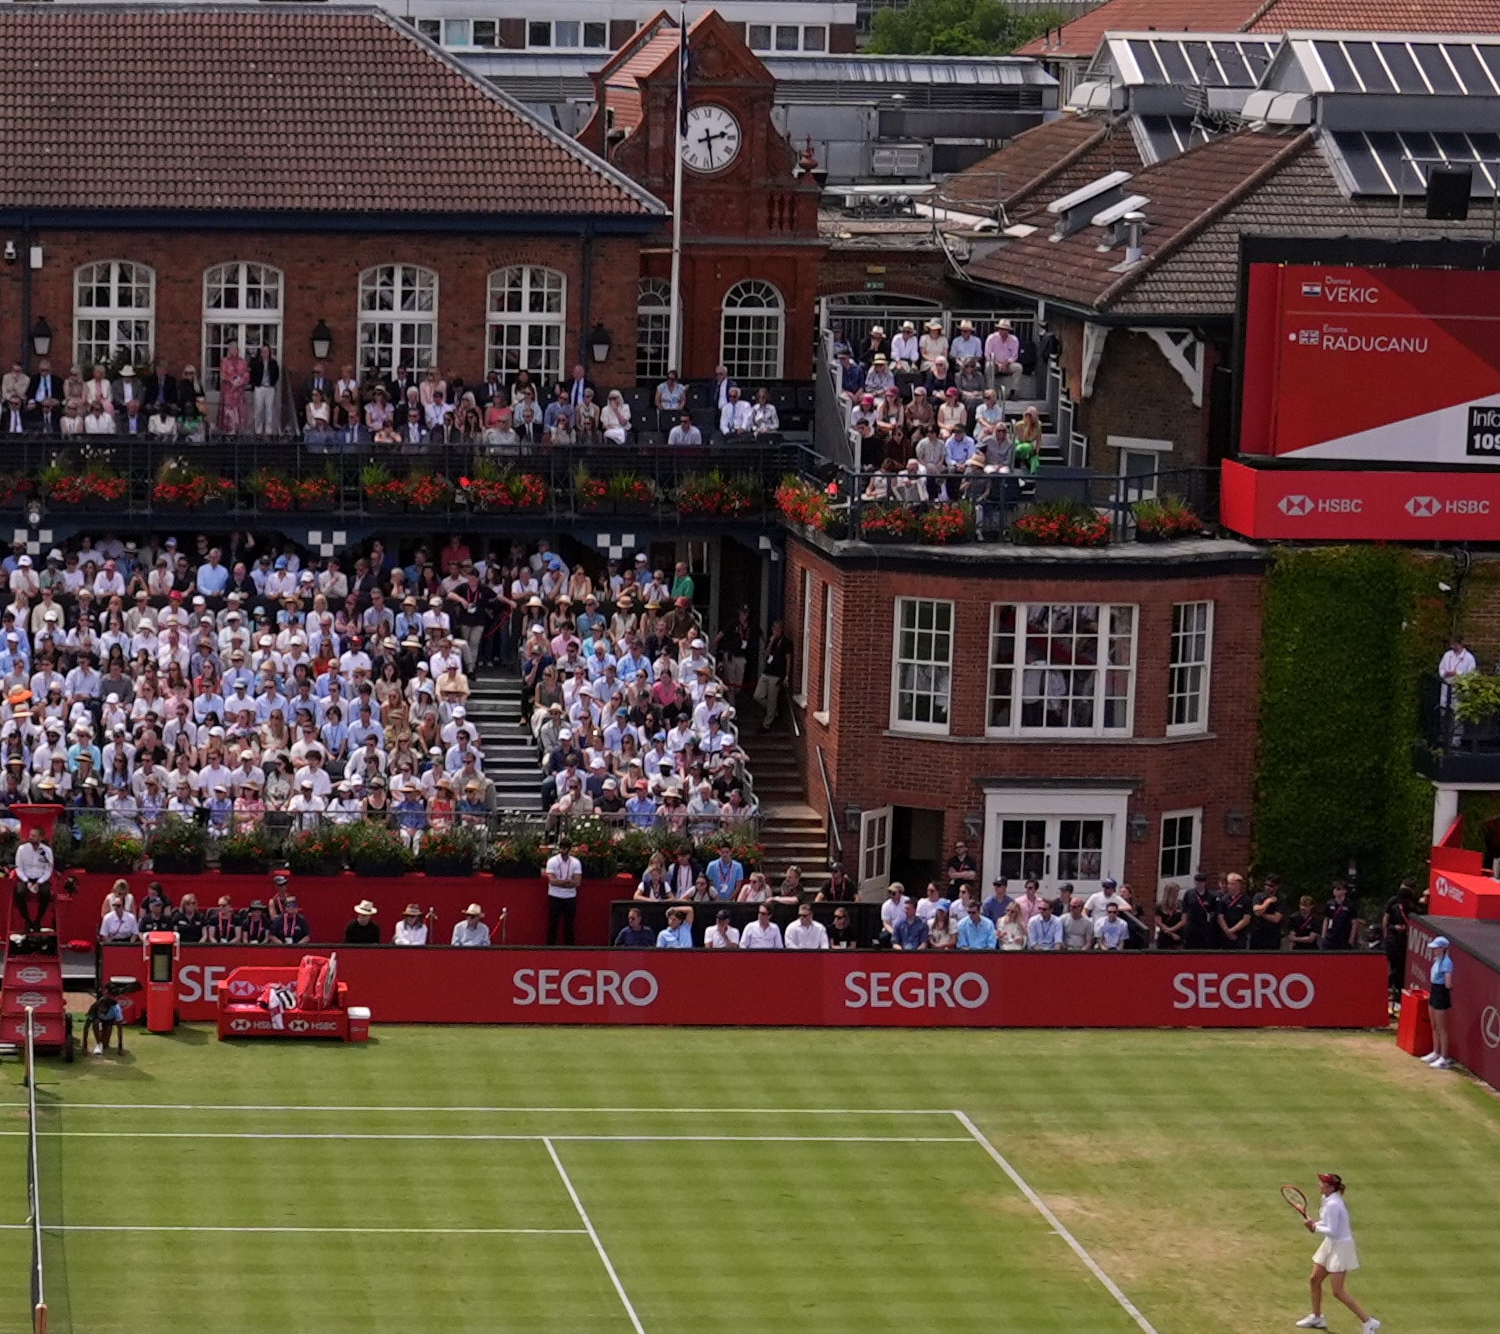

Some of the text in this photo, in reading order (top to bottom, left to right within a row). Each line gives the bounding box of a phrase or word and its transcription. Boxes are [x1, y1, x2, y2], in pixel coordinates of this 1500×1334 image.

[1324, 286, 1379, 304] VEKIC
[1322, 334, 1428, 354] RADUCANU
[1317, 499, 1364, 513] HSBC
[1445, 500, 1491, 514] HSBC
[512, 968, 659, 1008] SEGRO
[843, 971, 990, 1010] SEGRO
[1172, 972, 1316, 1011] SEGRO
